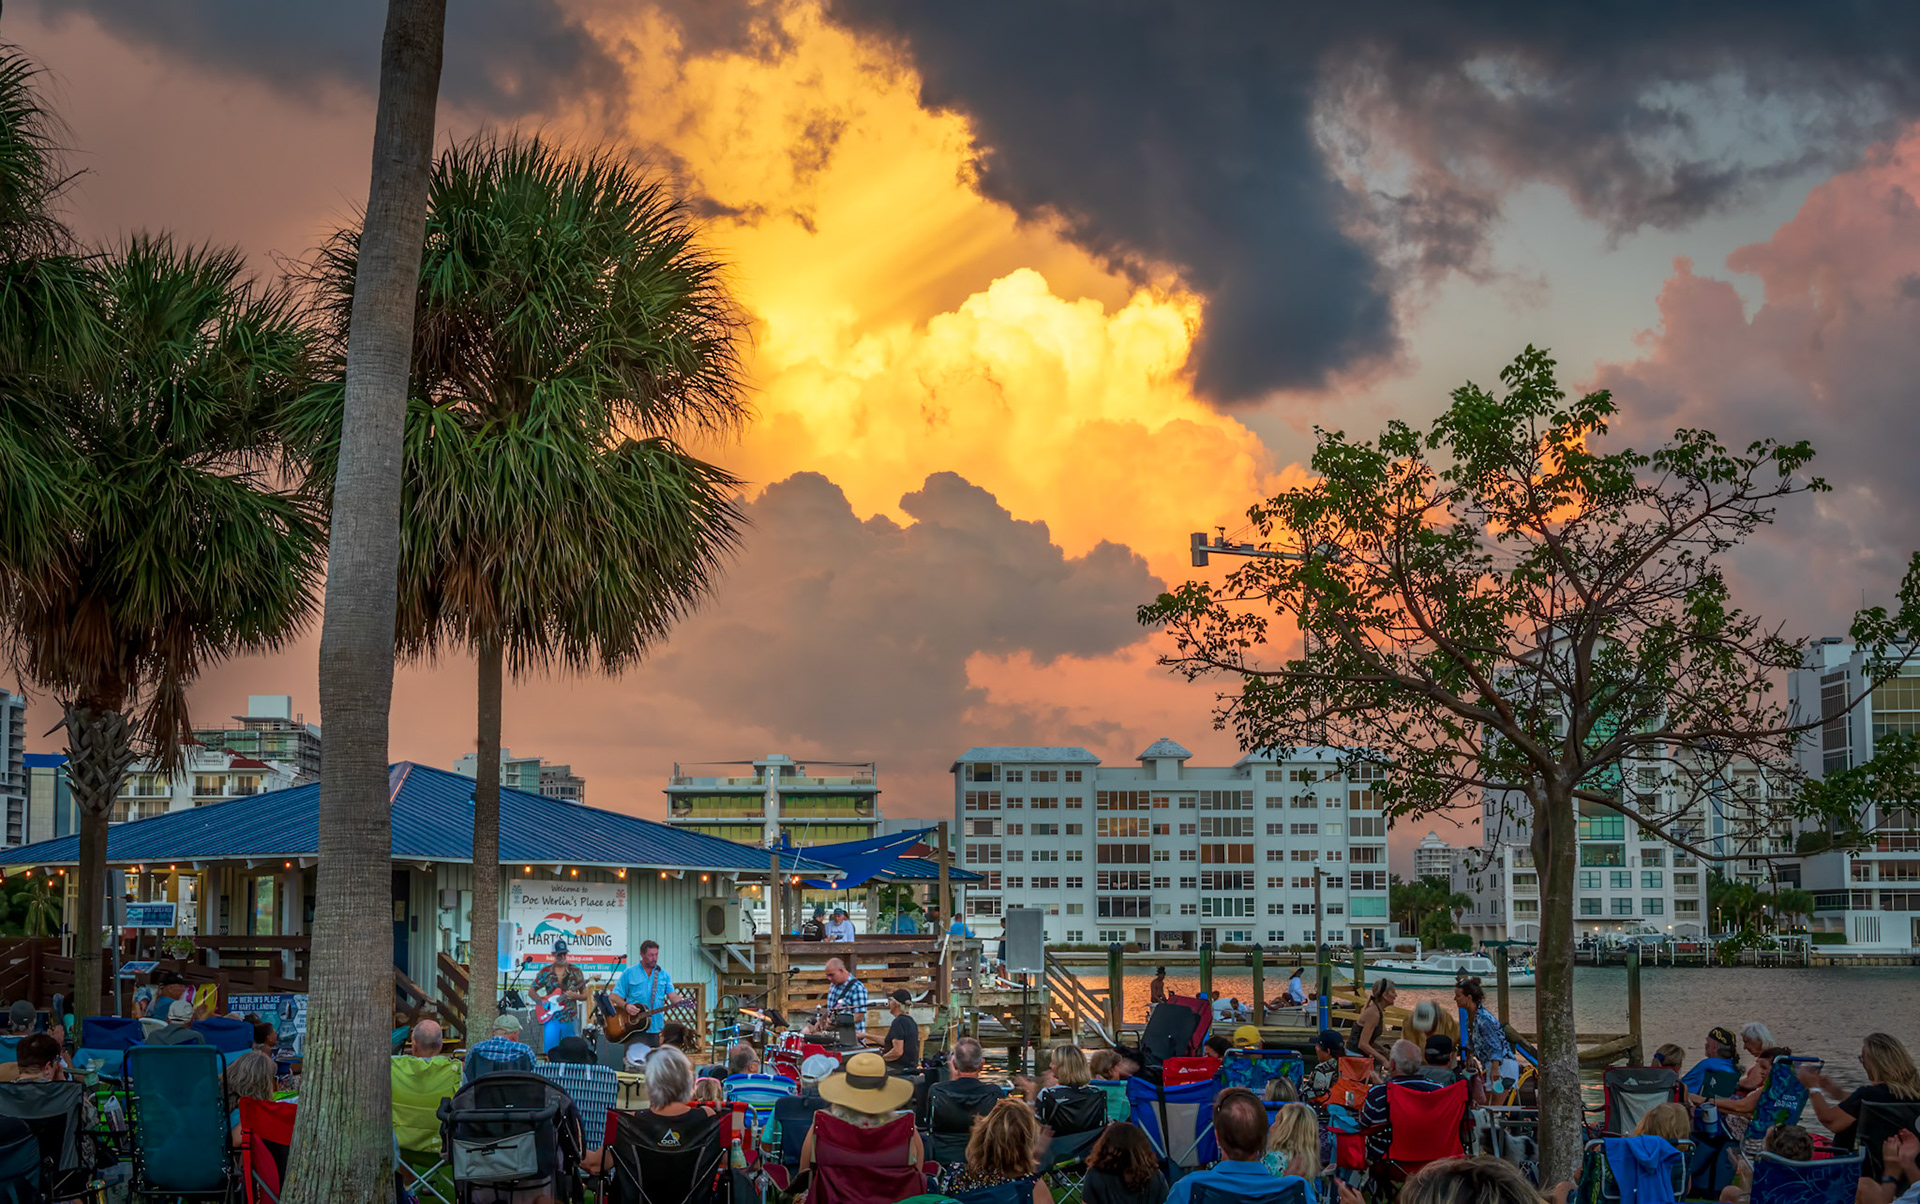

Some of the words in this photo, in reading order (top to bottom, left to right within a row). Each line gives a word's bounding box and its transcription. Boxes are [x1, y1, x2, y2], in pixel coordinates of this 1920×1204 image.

[551, 885, 580, 893] Welcome
[522, 895, 539, 904] Doc
[542, 896, 577, 906] Werlin's
[580, 897, 604, 906] Place
[528, 933, 563, 945] HART'S
[567, 934, 612, 946] LANDING
